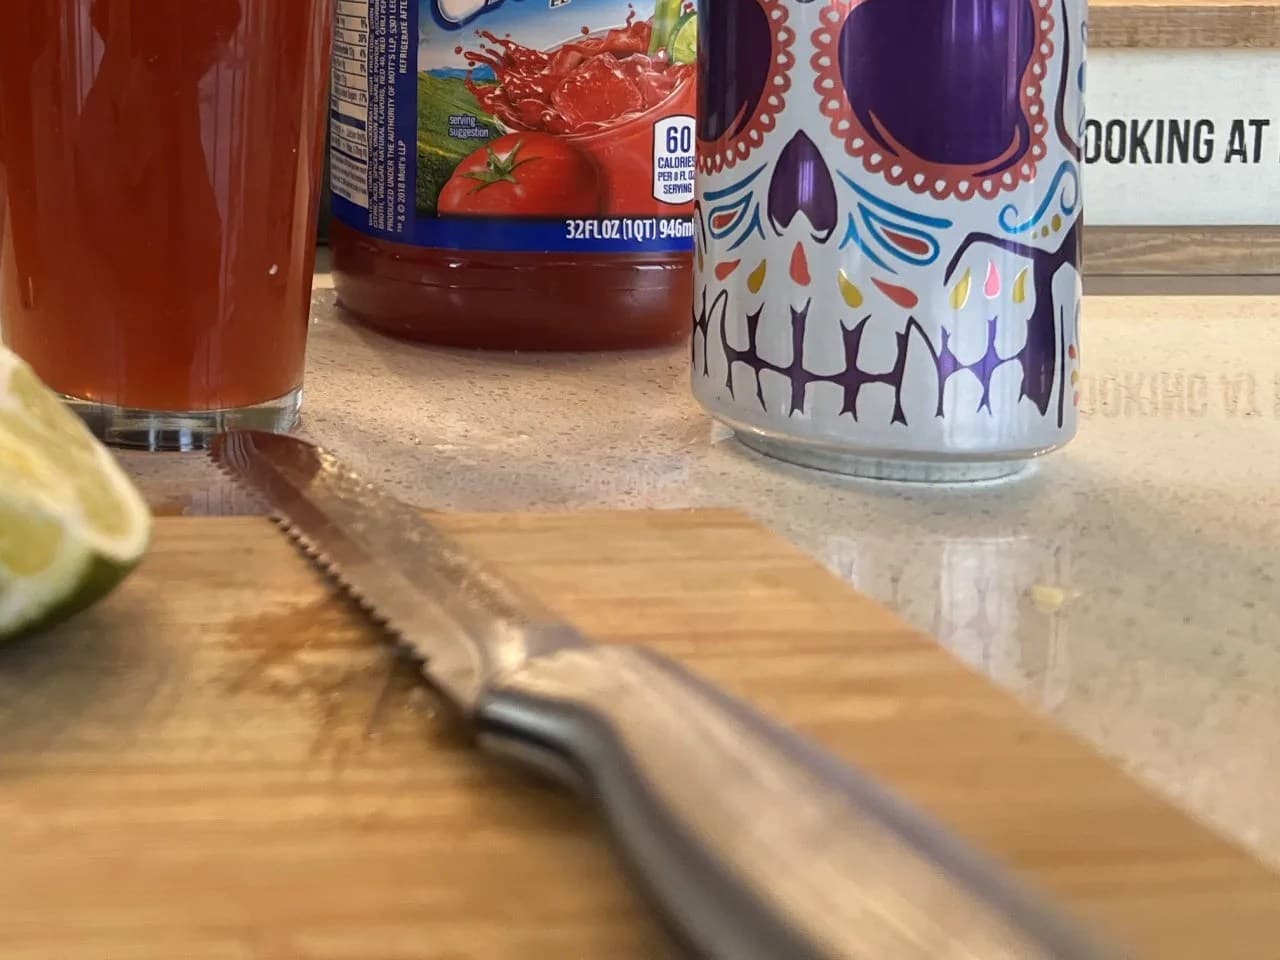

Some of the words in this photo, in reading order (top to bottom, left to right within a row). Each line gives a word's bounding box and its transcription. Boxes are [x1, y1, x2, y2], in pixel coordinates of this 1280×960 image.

[389, 16, 397, 34] 5301
[399, 22, 409, 74] REFRIGERATE
[388, 86, 395, 96] OF
[387, 98, 395, 142] AUTHORITY
[449, 115, 476, 128] serving
[449, 127, 489, 139] suggestion
[666, 125, 691, 154] 60
[1084, 119, 1215, 164] OOKING
[1223, 119, 1271, 164] AT
[398, 140, 406, 155] LLP
[398, 157, 406, 182] Mott's
[657, 171, 673, 181] PER
[679, 170, 687, 181] FL
[397, 183, 406, 203] 2018
[663, 183, 692, 194] SERVING
[386, 190, 394, 232] PRODUCED
[622, 218, 657, 242] (1QT)
